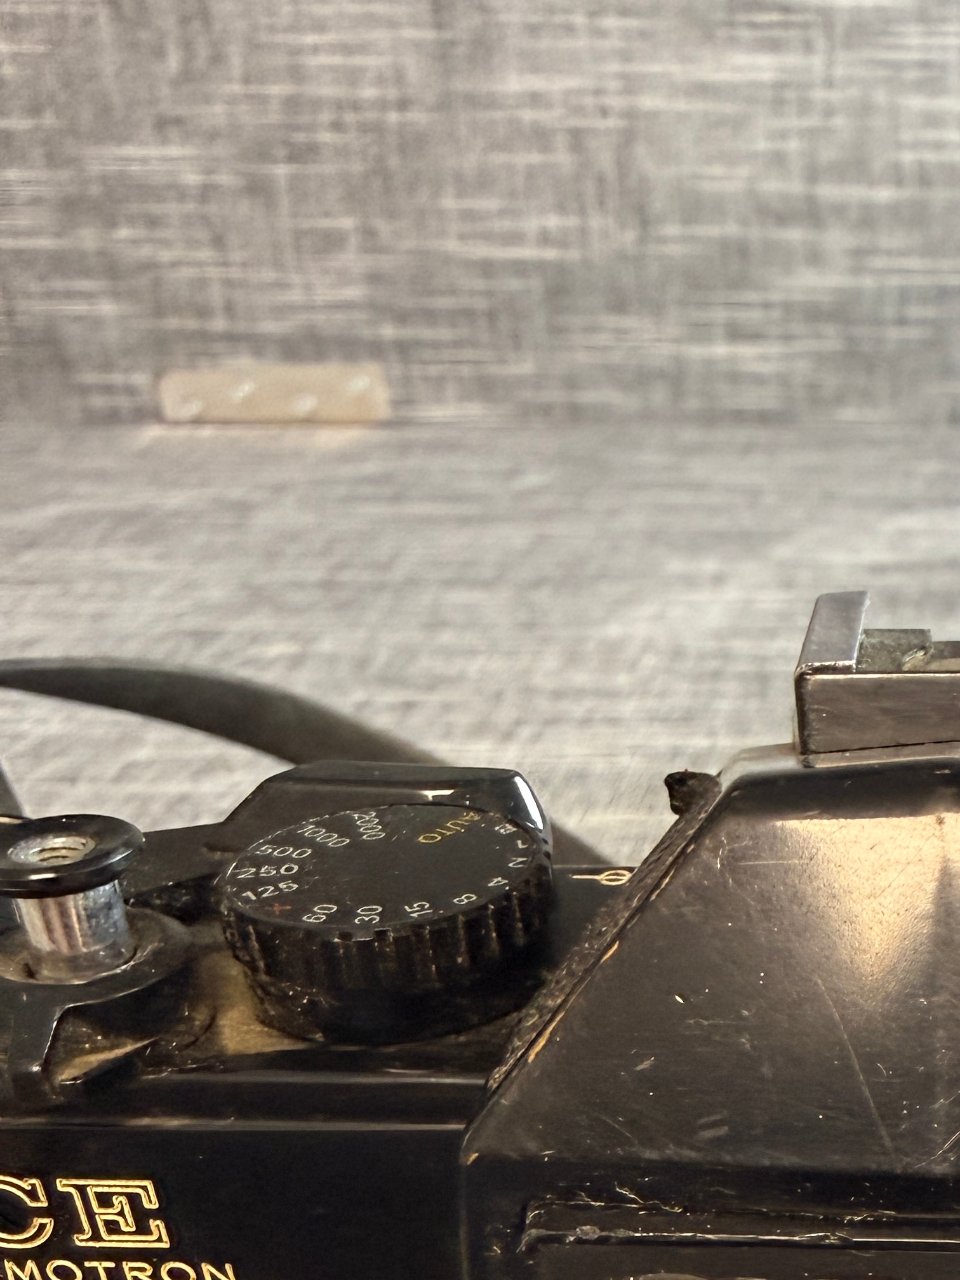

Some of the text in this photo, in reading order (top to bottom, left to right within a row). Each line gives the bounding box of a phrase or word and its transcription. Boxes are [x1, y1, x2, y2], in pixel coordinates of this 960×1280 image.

[352, 811, 386, 840] 2000
[297, 825, 350, 848] 1000
[255, 844, 313, 859] 500
[236, 862, 299, 879] 250
[241, 880, 299, 901] 125
[487, 876, 509, 888] 4
[404, 900, 431, 918] 15
[453, 893, 477, 906] 8
[302, 904, 338, 924] 60
[354, 904, 383, 925] 30
